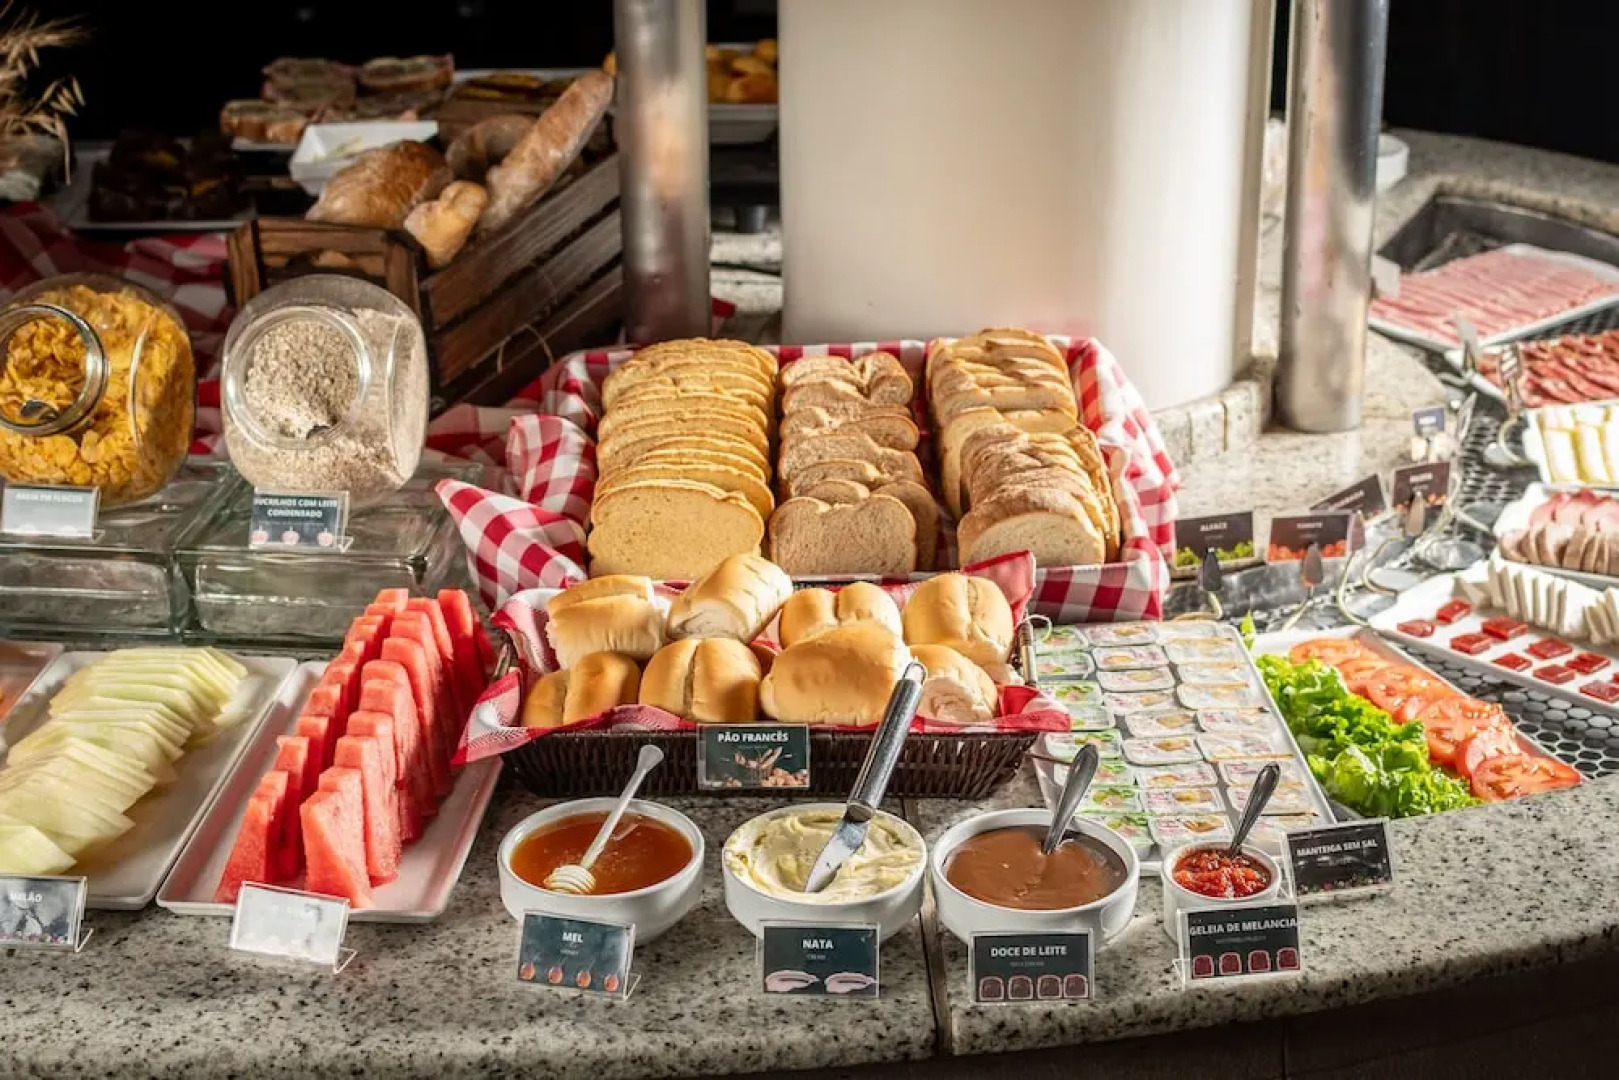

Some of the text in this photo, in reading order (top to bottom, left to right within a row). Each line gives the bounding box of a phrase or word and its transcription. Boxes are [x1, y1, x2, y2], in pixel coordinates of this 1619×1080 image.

[298, 499, 317, 507] COM
[267, 509, 323, 518] CONDENSADO
[718, 729, 789, 743] PÃO FRANCÊS
[1190, 917, 1298, 936] GELEIA DE MELANCIA
[562, 932, 584, 943] MEL
[802, 939, 834, 950] NATA
[990, 945, 1067, 957] DOCE DE LEITE
